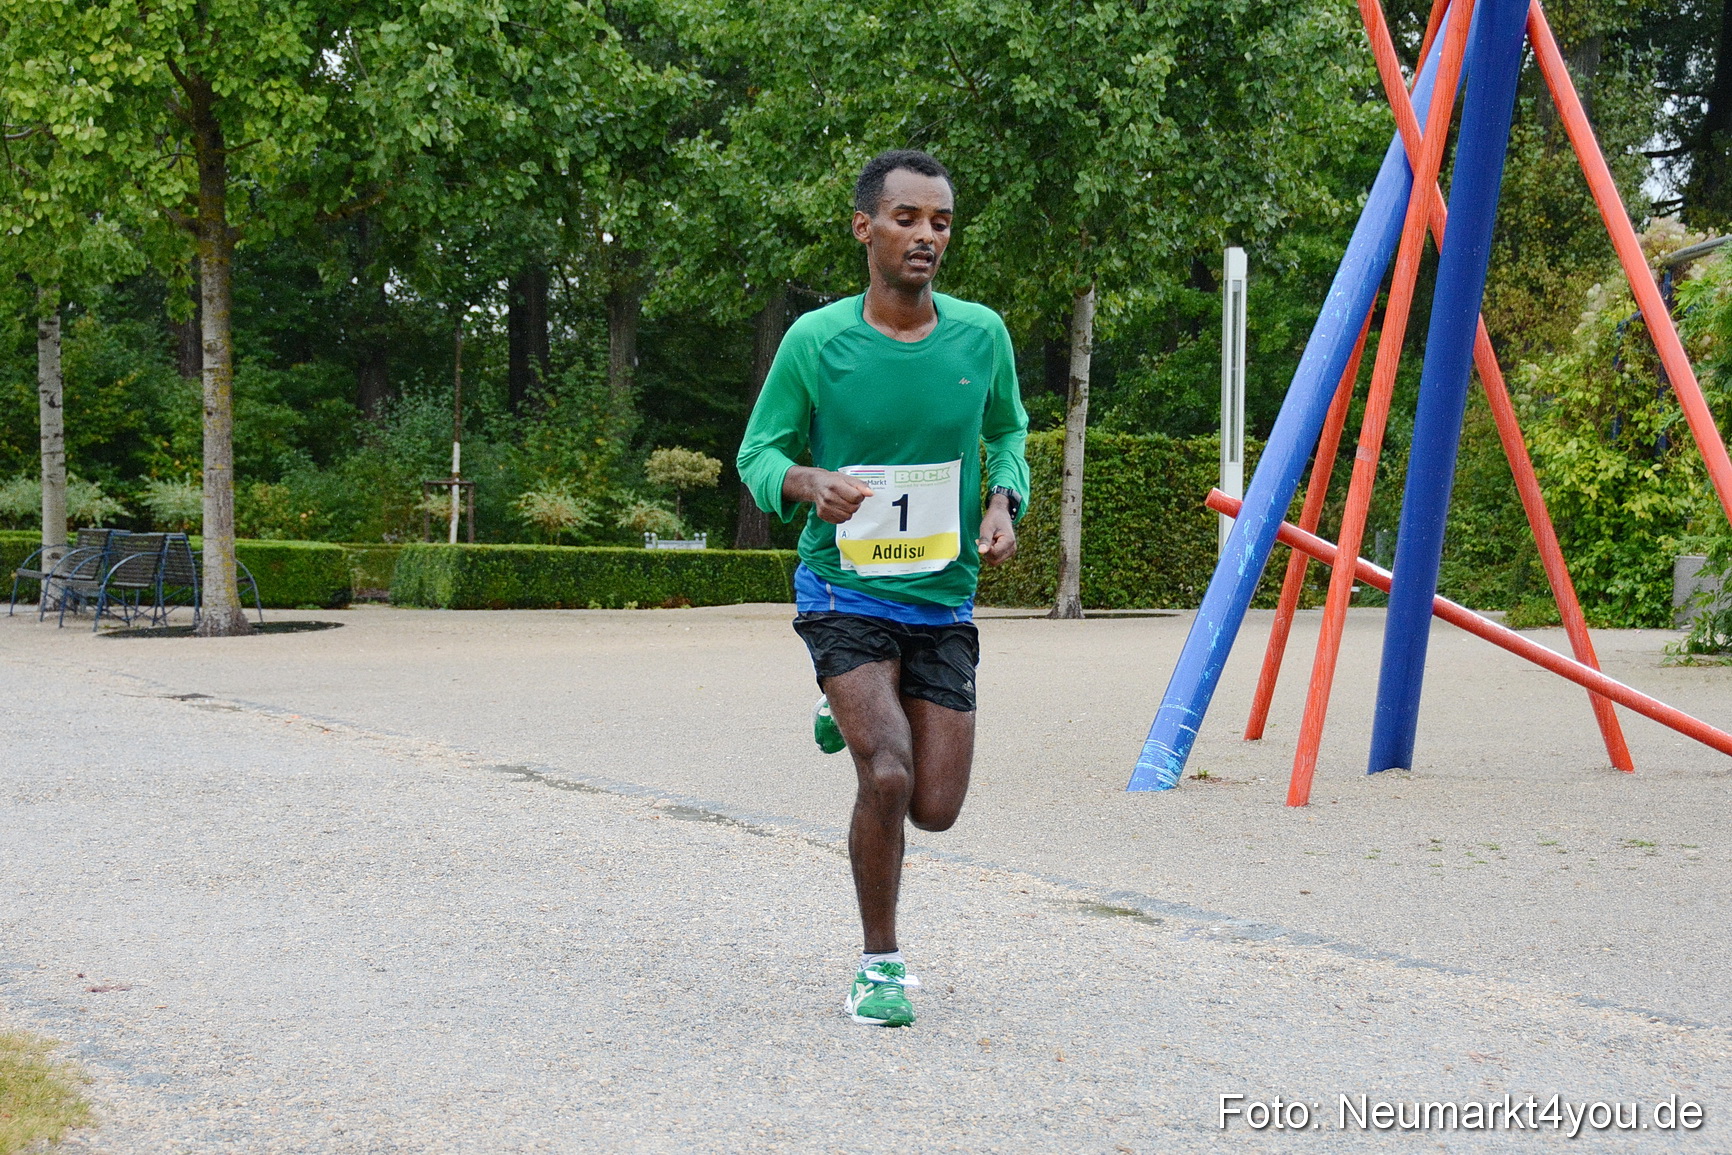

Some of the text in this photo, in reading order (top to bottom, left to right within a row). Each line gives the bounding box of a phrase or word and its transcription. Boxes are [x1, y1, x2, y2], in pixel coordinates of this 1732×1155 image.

[894, 467, 951, 484] BOCK
[892, 494, 909, 532] 1
[842, 530, 847, 538] A
[872, 544, 925, 560] Addisu
